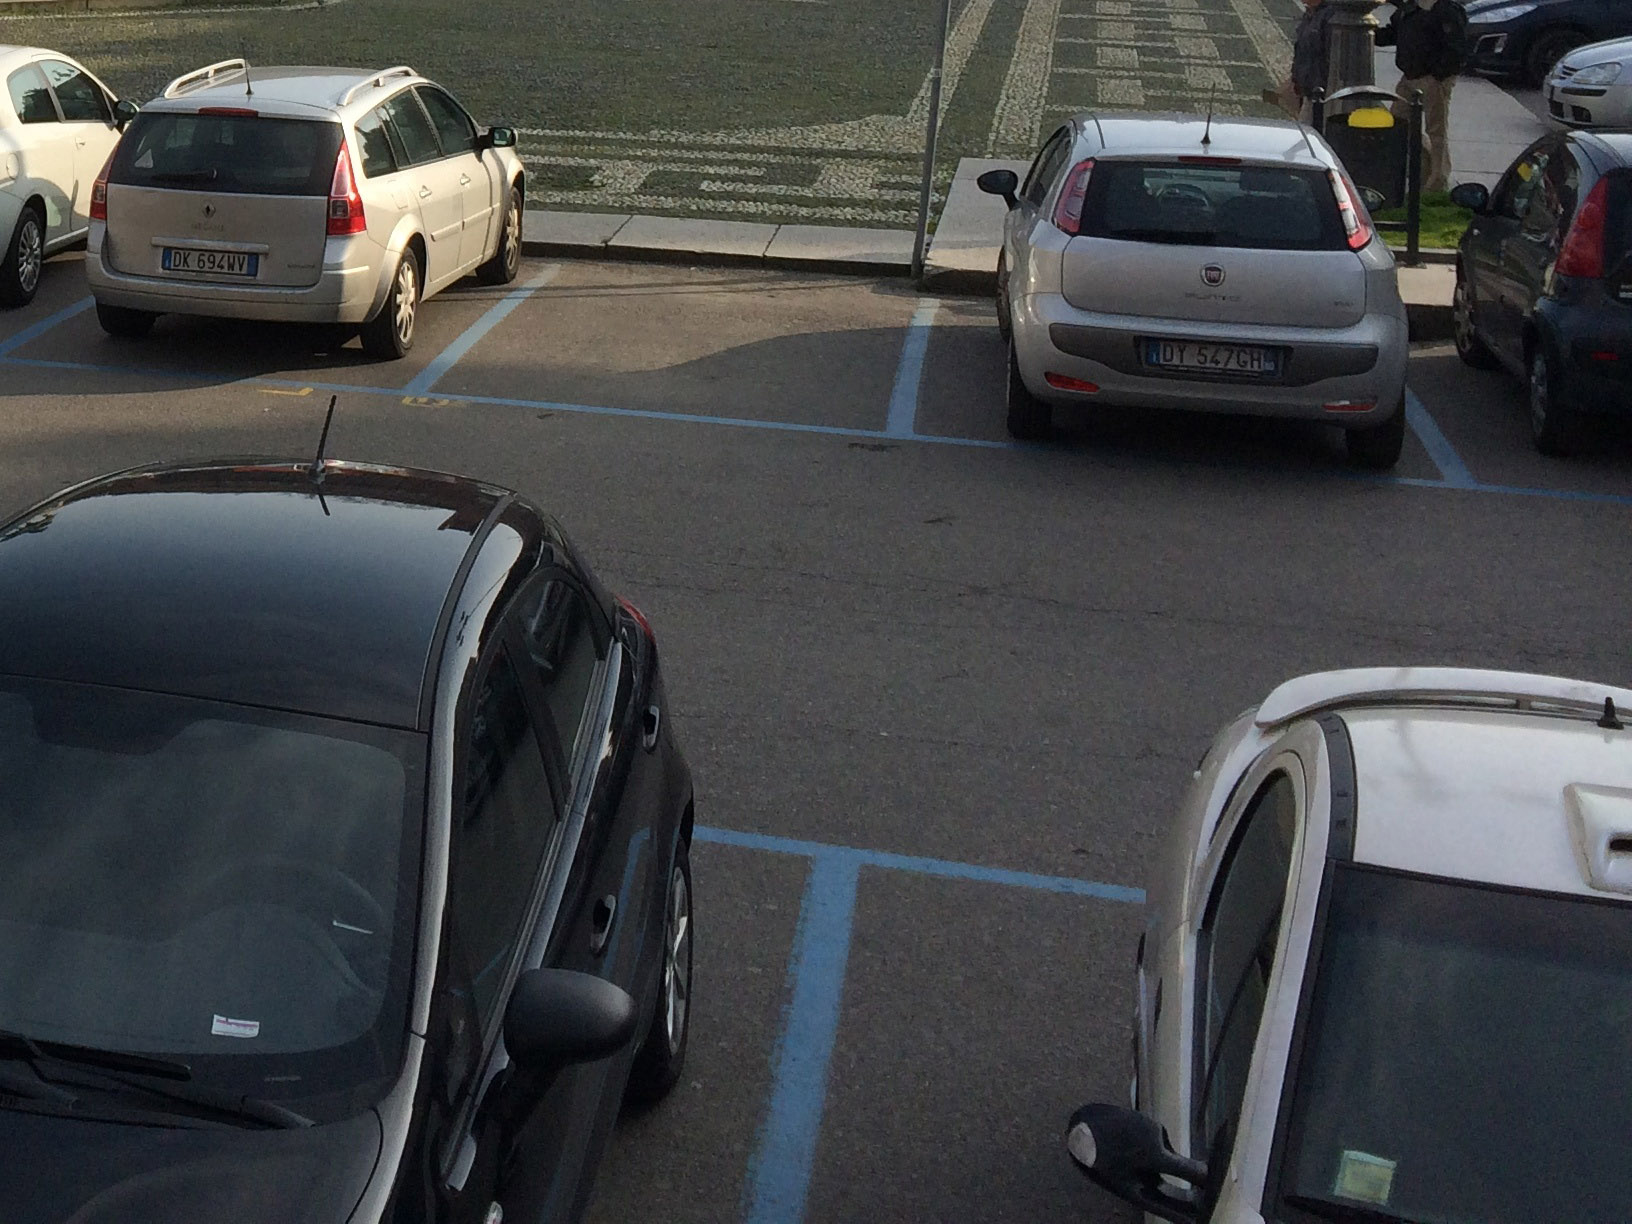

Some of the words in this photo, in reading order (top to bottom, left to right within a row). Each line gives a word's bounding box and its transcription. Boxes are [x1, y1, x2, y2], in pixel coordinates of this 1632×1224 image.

[172, 251, 191, 269] DK
[197, 253, 246, 273] 694WV
[1162, 344, 1187, 364] DY
[1196, 347, 1264, 371] 547GH
